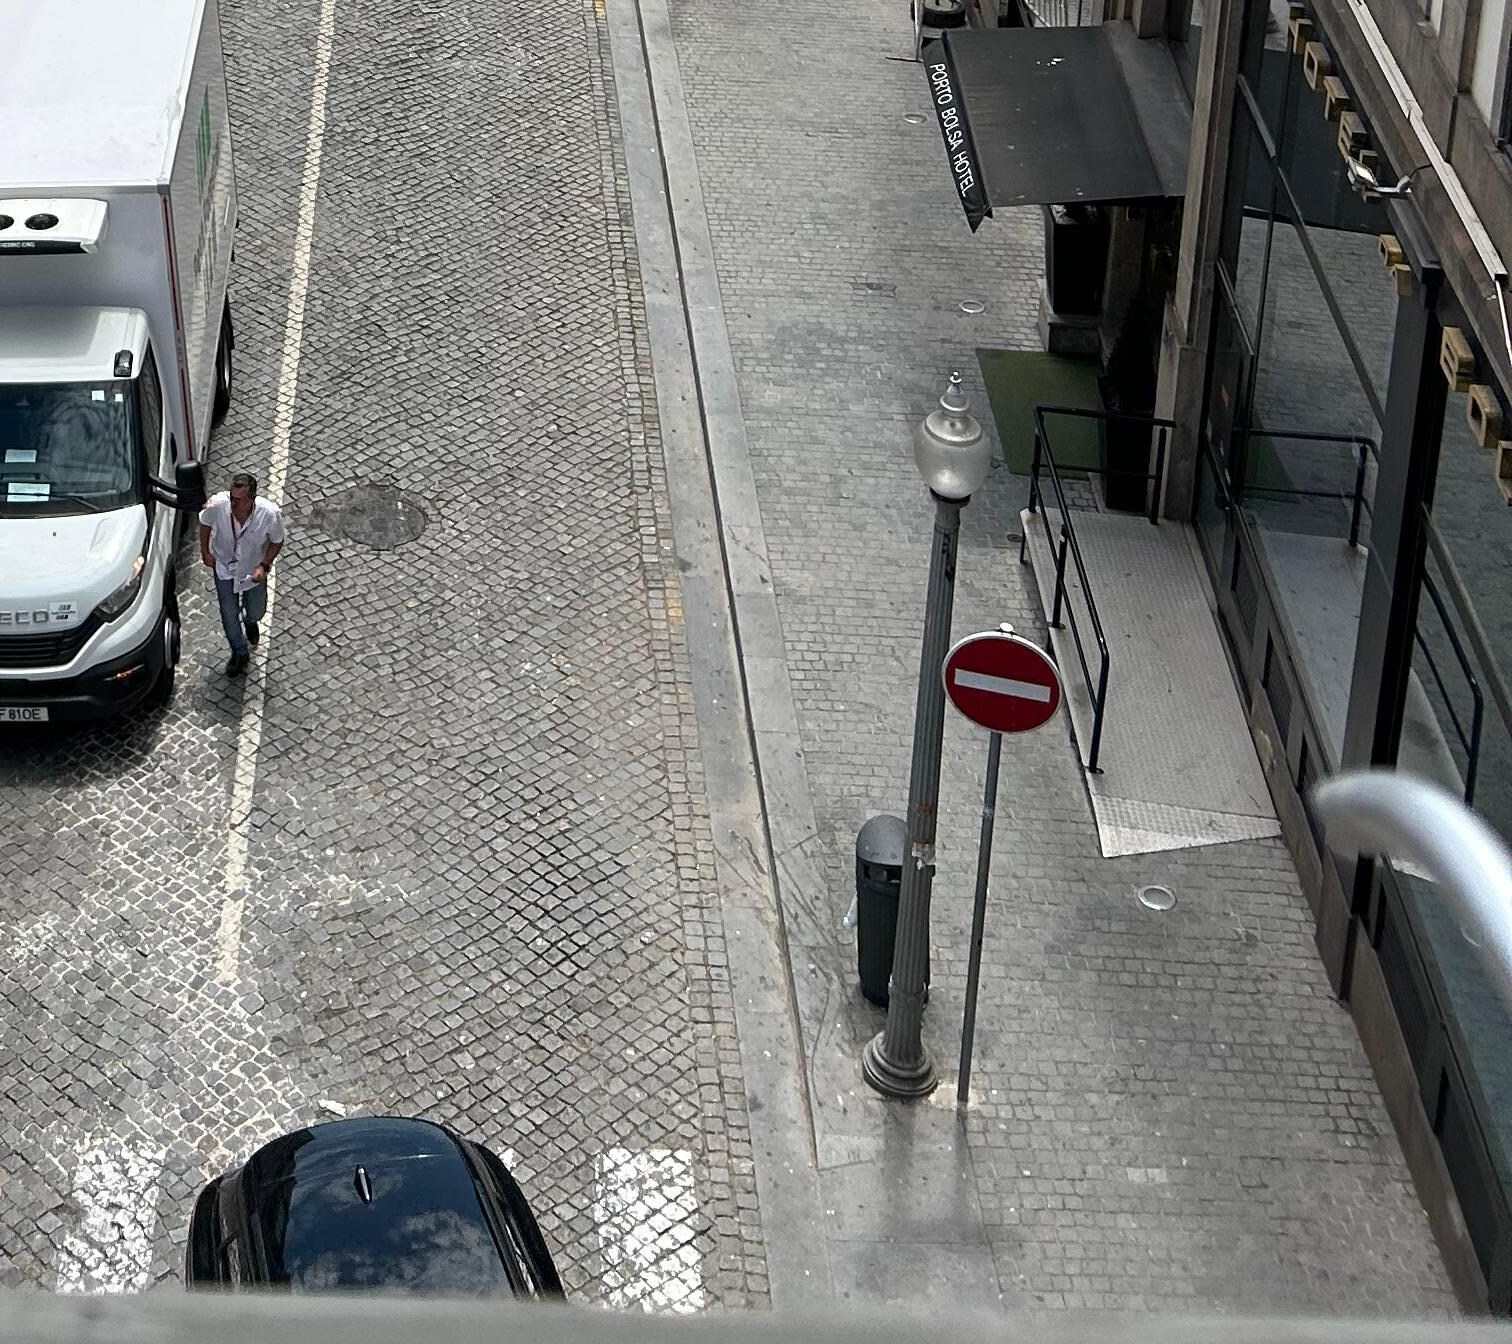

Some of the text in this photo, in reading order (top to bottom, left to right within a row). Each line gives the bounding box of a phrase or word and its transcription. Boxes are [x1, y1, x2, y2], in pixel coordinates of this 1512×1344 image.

[929, 62, 976, 198] PORTO BOLSA HOTEL
